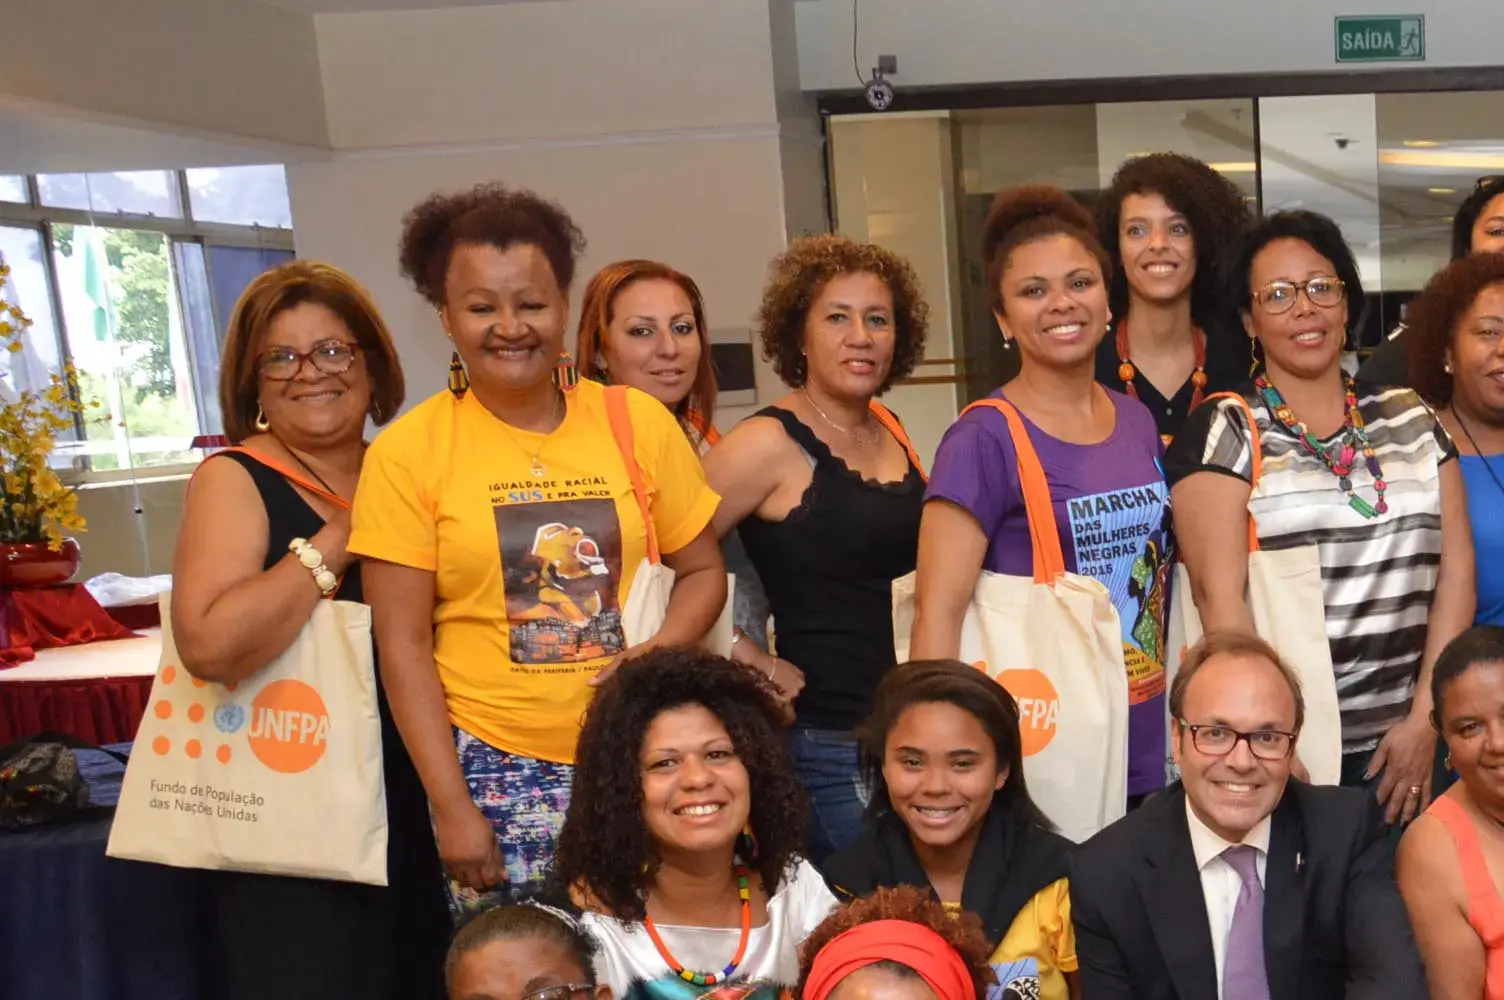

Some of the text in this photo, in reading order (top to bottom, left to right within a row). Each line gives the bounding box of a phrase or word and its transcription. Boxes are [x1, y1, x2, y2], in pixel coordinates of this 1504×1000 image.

[1342, 28, 1394, 50] SAÍDA
[489, 476, 608, 491] IGUALDADE RACIAL
[508, 490, 543, 502] SUS
[558, 491, 577, 499] PRA
[582, 490, 610, 498] VALER
[1071, 487, 1161, 520] MARCHA
[1075, 519, 1102, 534] DAS
[1076, 522, 1150, 547] MULHERES
[1079, 541, 1137, 562] NEGRAS
[1081, 563, 1113, 576] 2015
[1017, 697, 1060, 730] FPA
[249, 707, 331, 746] UNFPA
[150, 779, 264, 806] Fundo de População
[149, 797, 170, 810] das
[217, 807, 258, 823] Unidas
